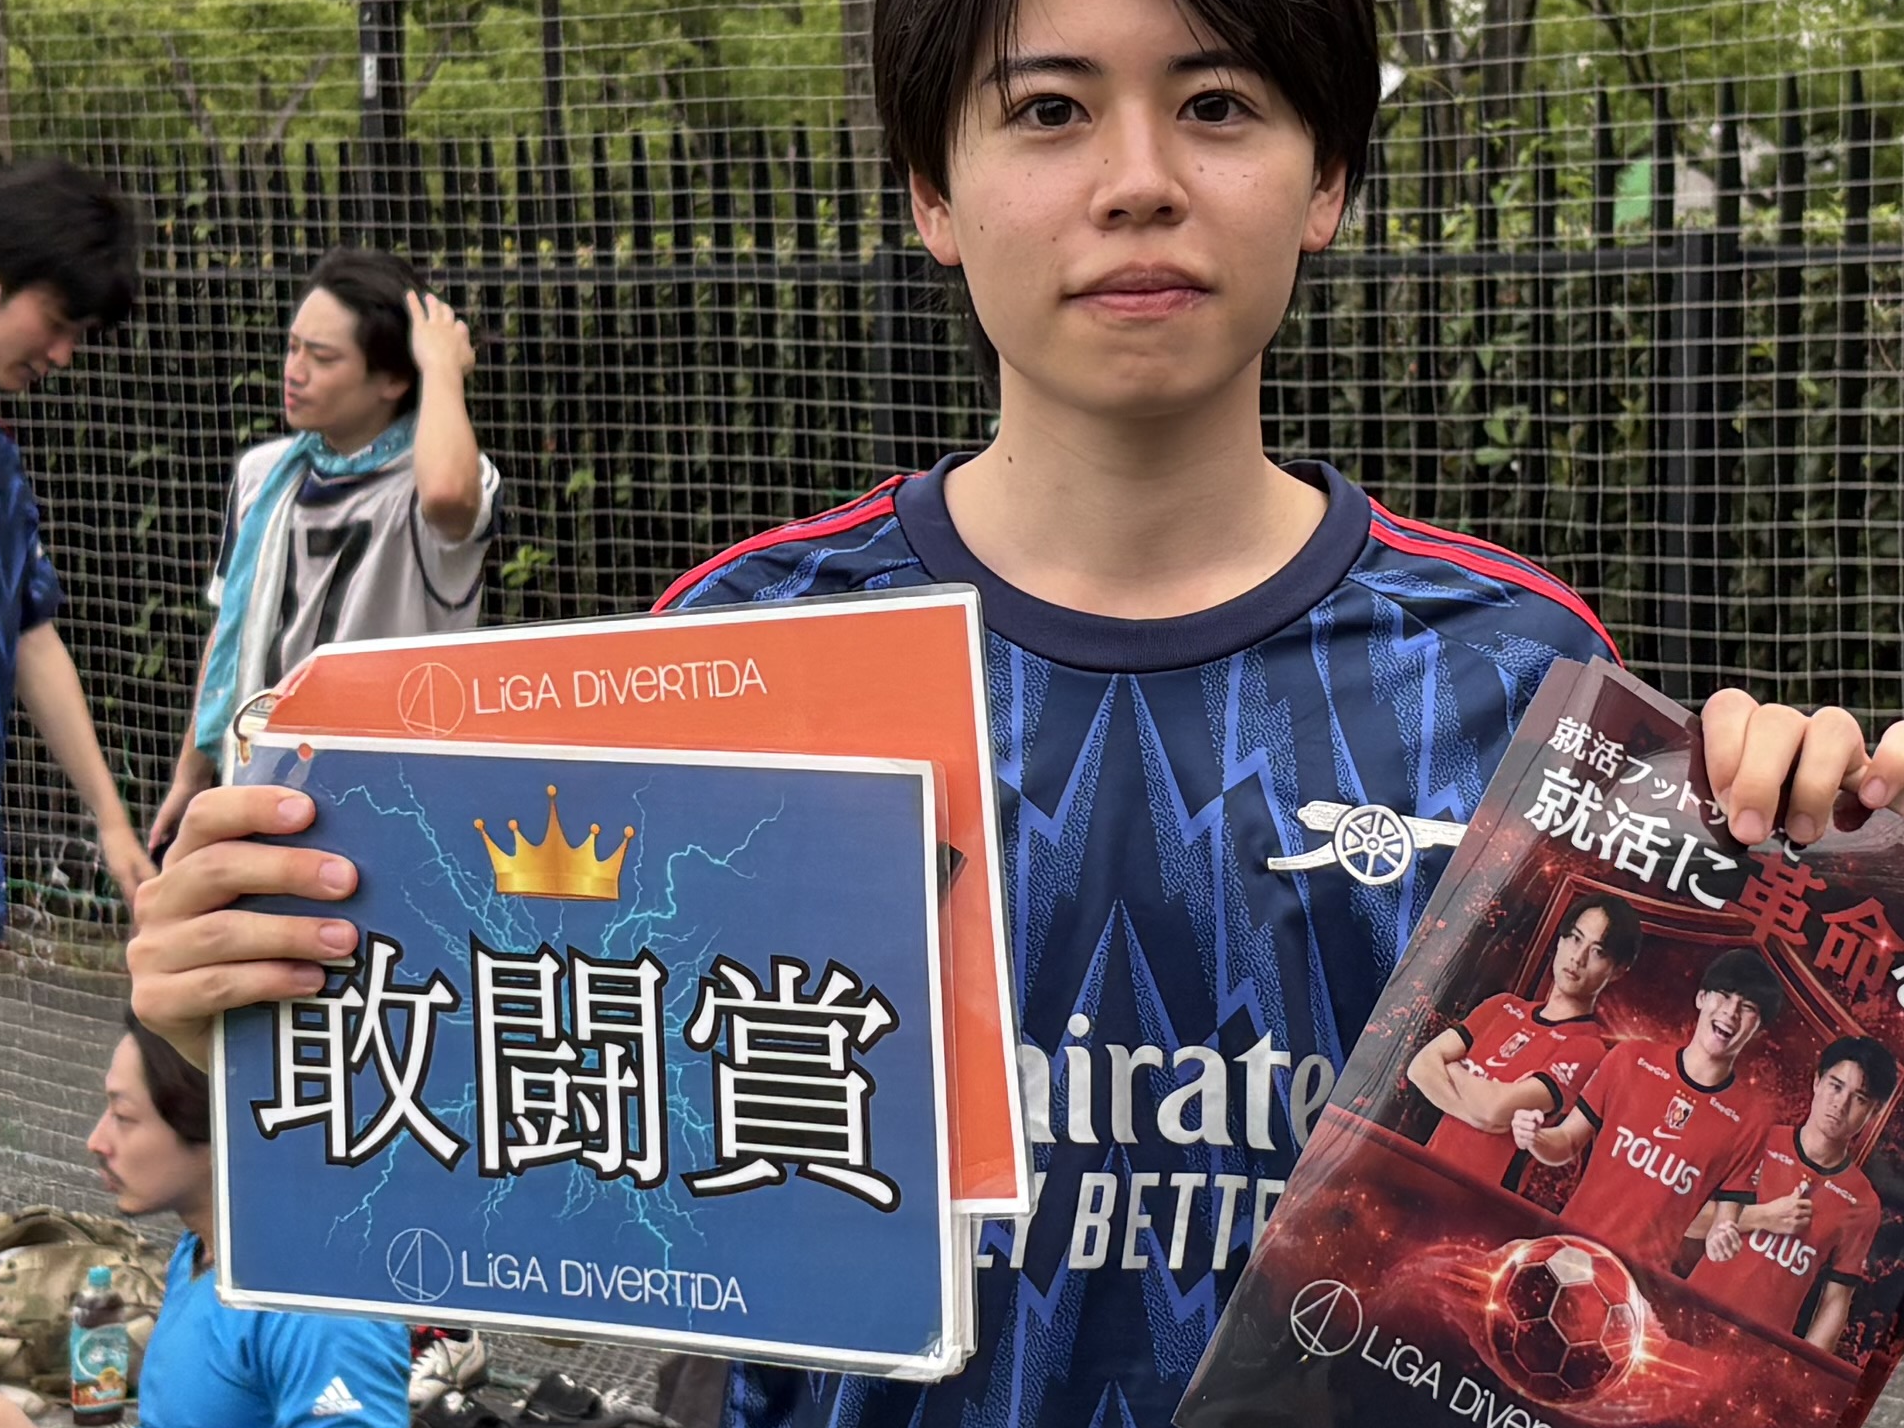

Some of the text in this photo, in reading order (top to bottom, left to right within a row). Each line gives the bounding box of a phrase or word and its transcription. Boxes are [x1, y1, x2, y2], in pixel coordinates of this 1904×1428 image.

[250, 930, 900, 1213] 敢闘賞
[1610, 1125, 1701, 1196] POLUS
